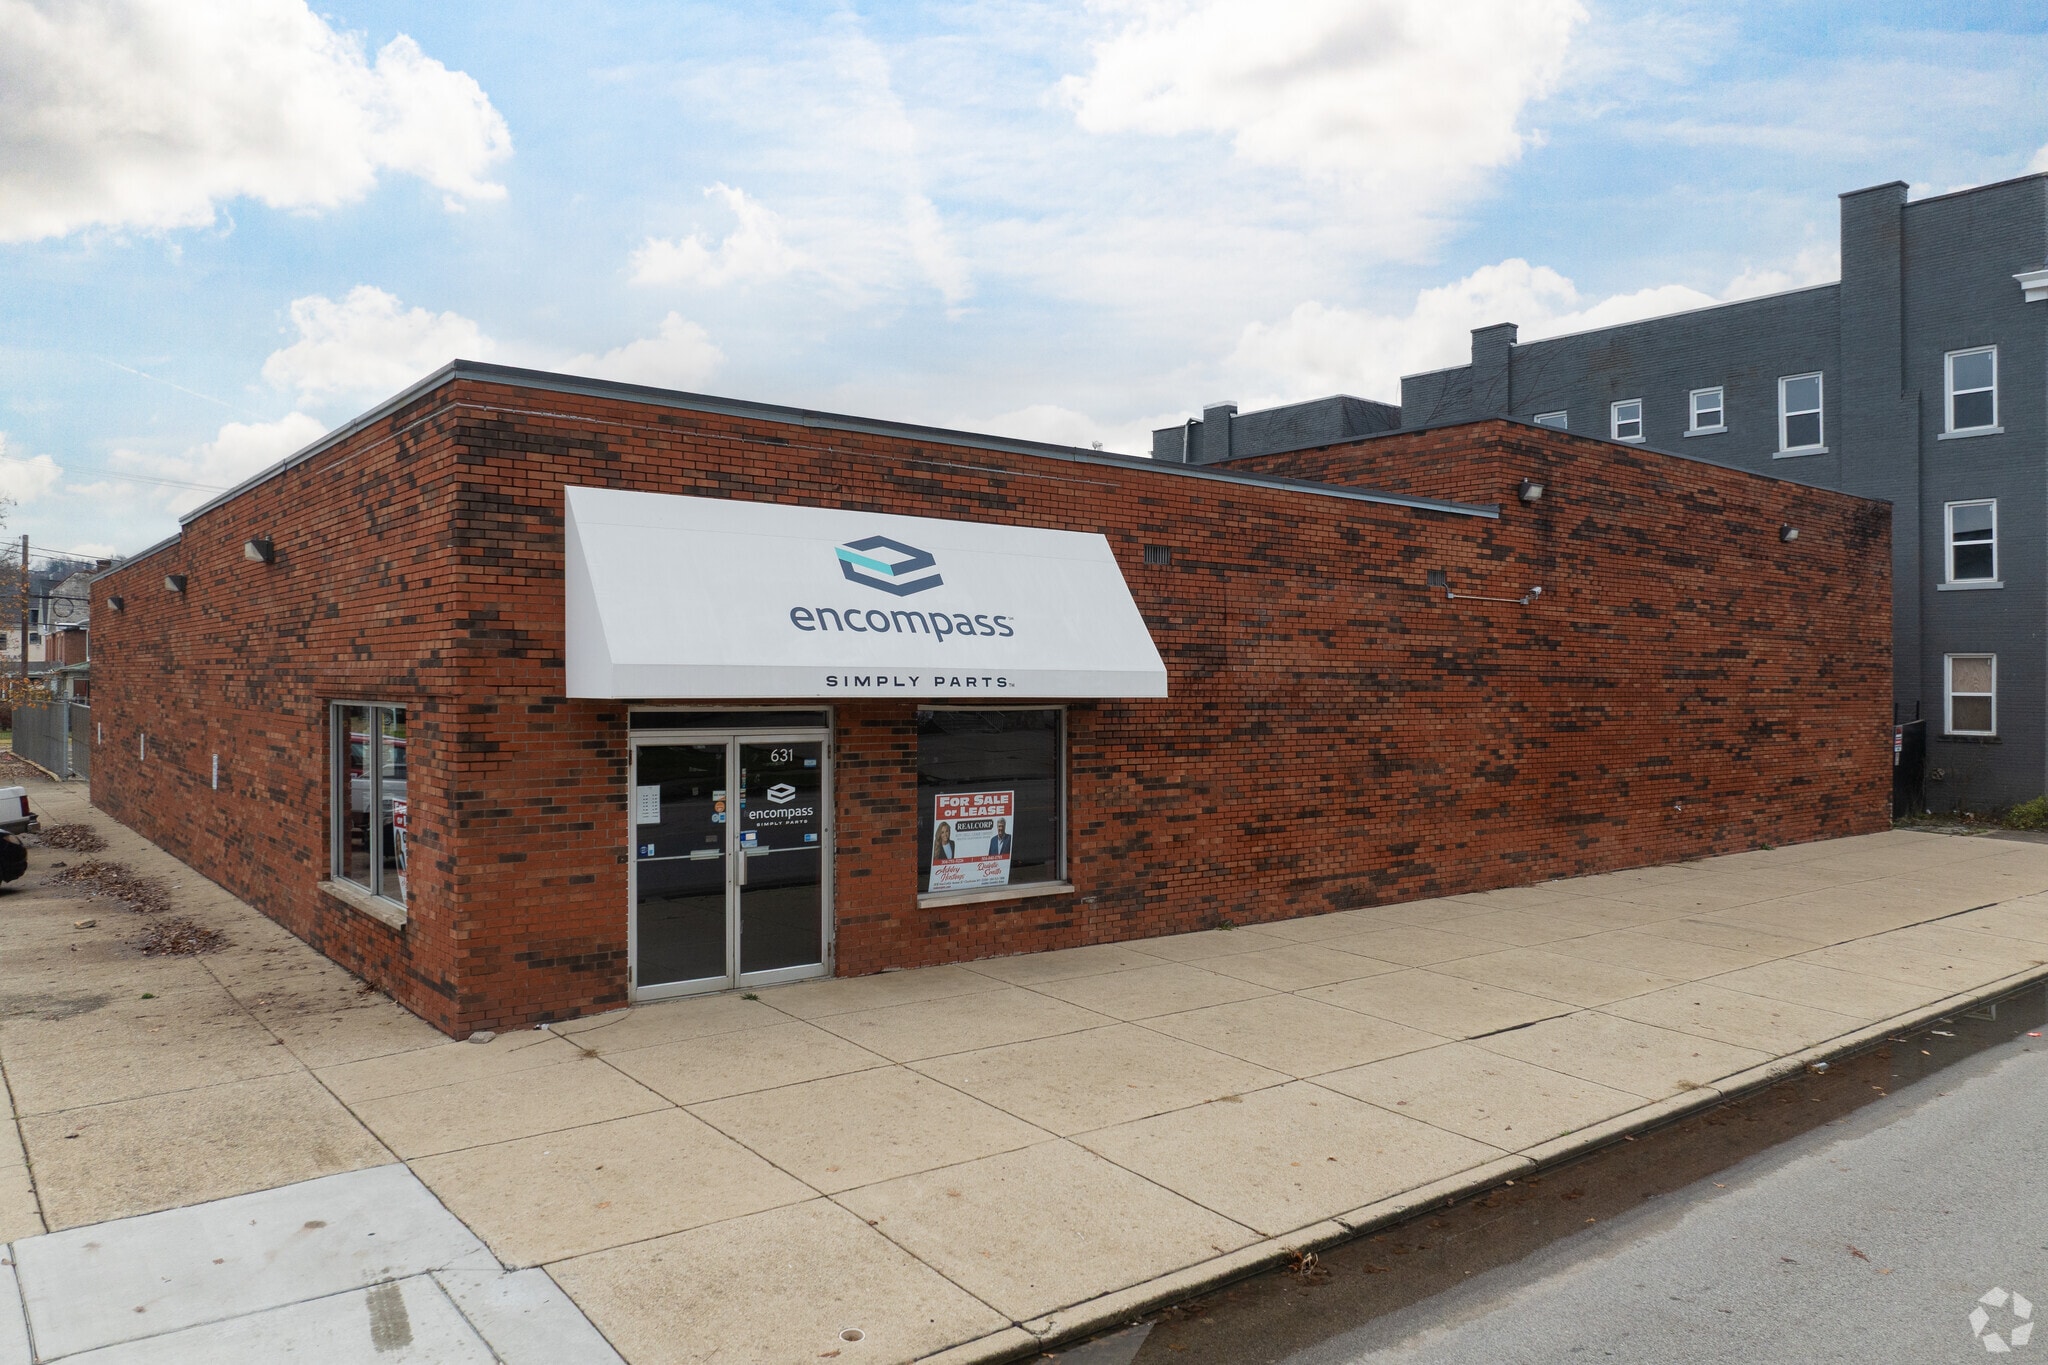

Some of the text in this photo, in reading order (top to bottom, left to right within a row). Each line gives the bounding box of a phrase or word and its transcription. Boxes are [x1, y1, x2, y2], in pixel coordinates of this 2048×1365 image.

[789, 606, 1014, 643] encompass
[826, 675, 920, 687] SIMPLY
[934, 676, 1008, 688] PARTS
[770, 748, 794, 762] 631
[940, 794, 1009, 808] FOR SALE
[749, 807, 814, 820] encompass
[960, 805, 1005, 817] LEASE
[957, 821, 992, 831] REALCORP
